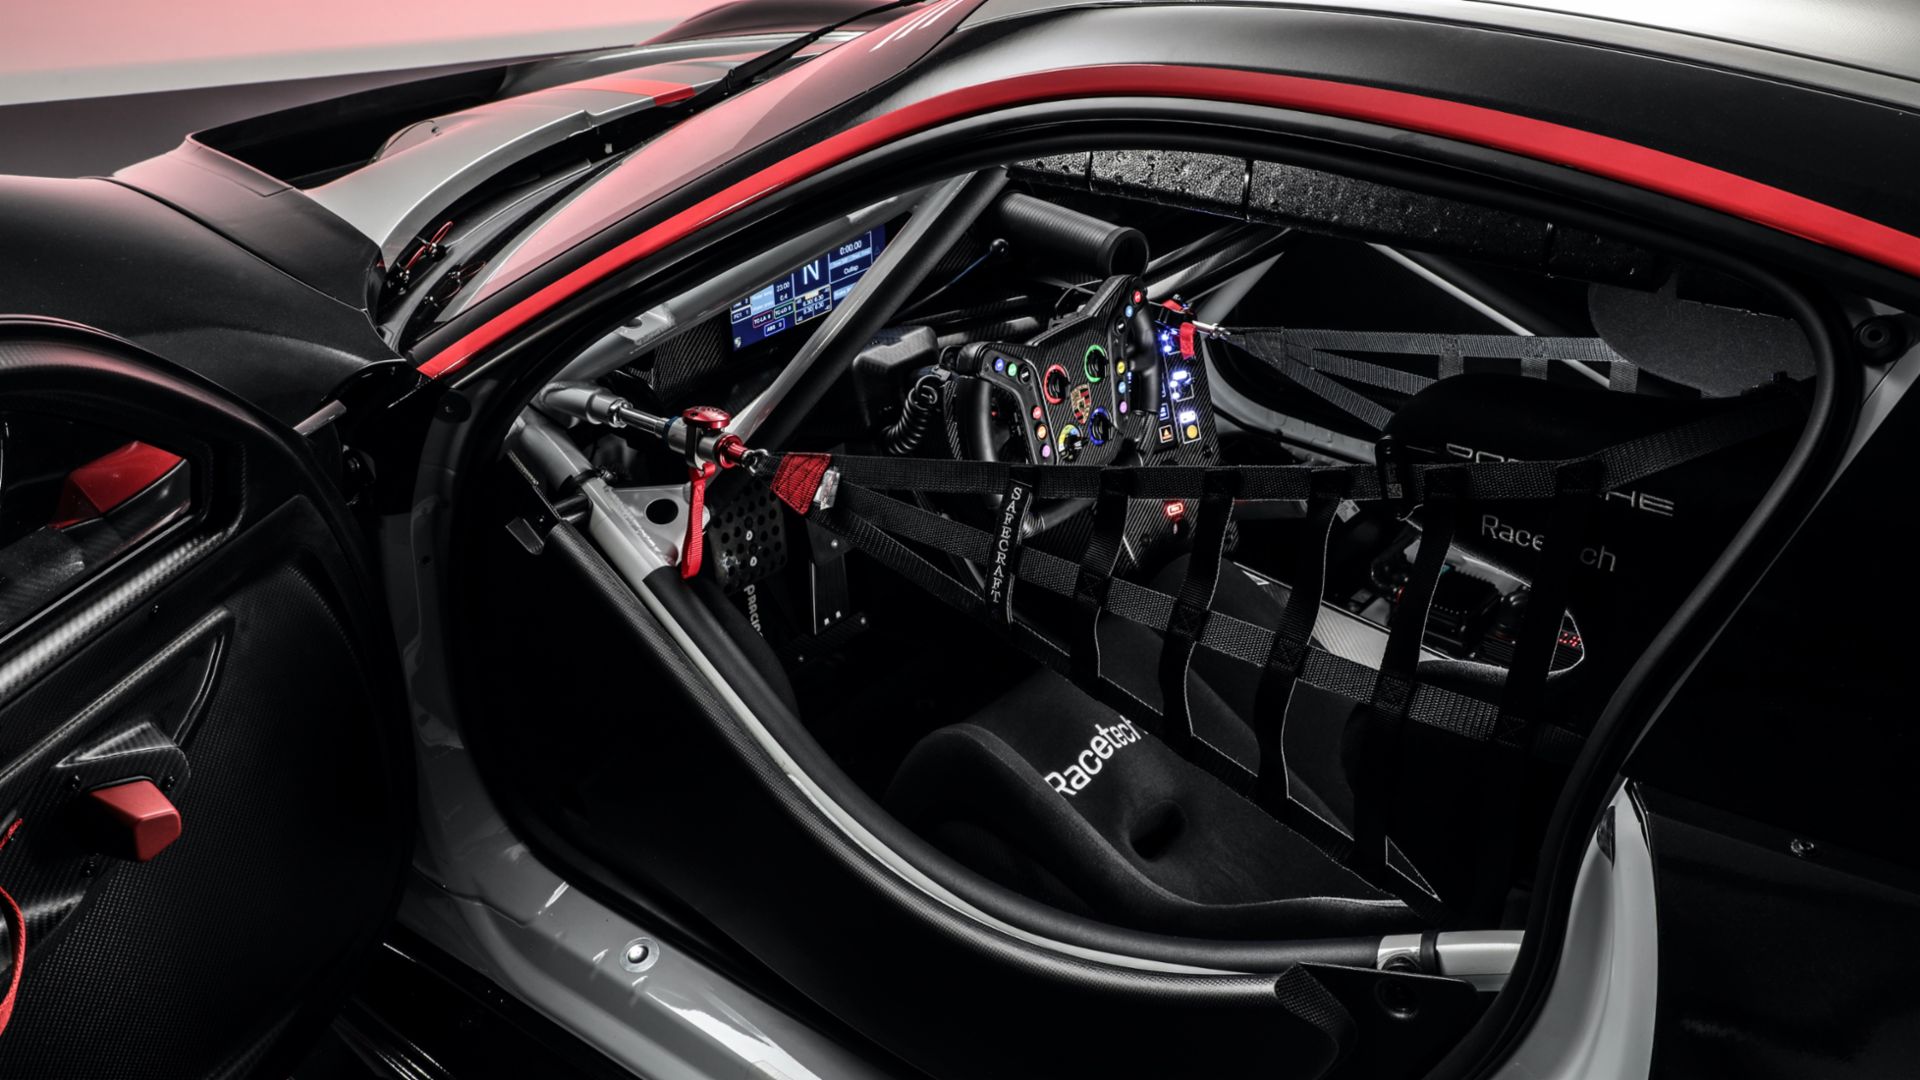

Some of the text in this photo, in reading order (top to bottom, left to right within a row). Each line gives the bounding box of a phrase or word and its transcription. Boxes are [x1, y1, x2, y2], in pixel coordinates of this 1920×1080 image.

[803, 260, 820, 285] N
[991, 487, 1022, 603] SAFECRAFT
[1481, 514, 1617, 572] Racech
